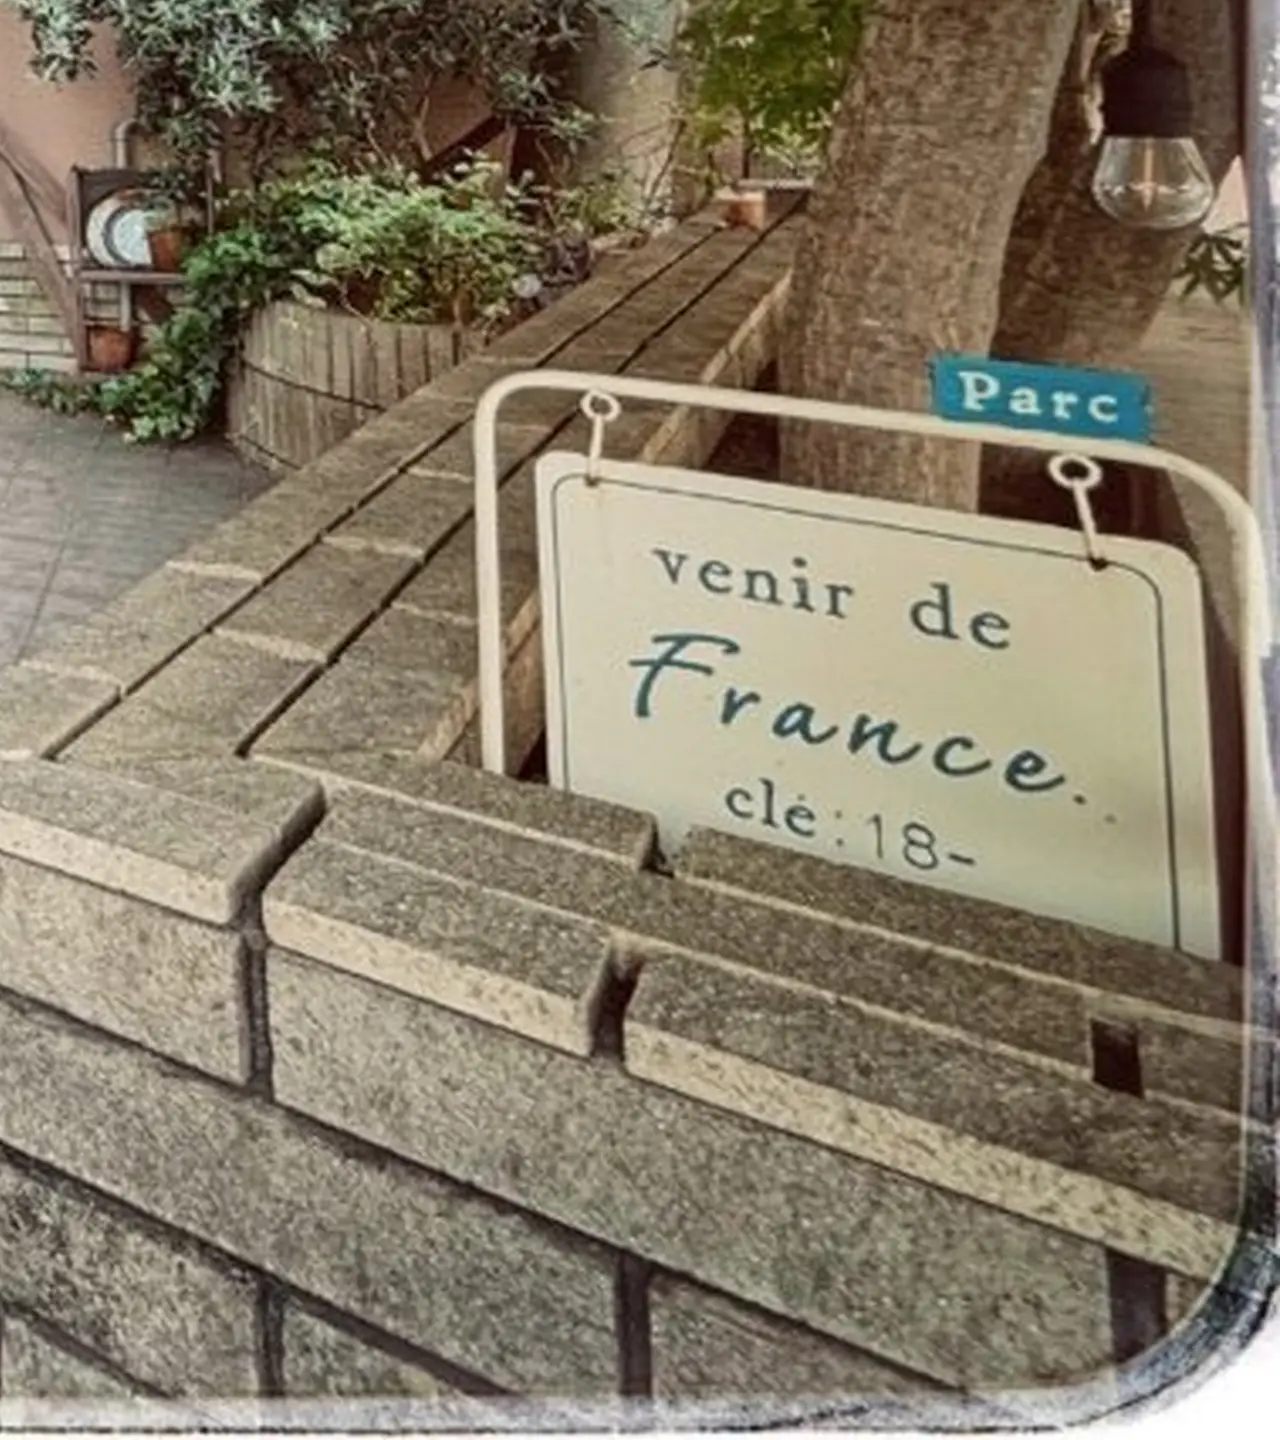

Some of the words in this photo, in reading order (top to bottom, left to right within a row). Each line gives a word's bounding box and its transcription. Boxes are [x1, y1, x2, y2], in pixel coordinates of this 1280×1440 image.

[957, 370, 1121, 426] Parc
[652, 546, 856, 620] venir
[908, 582, 1013, 652] de
